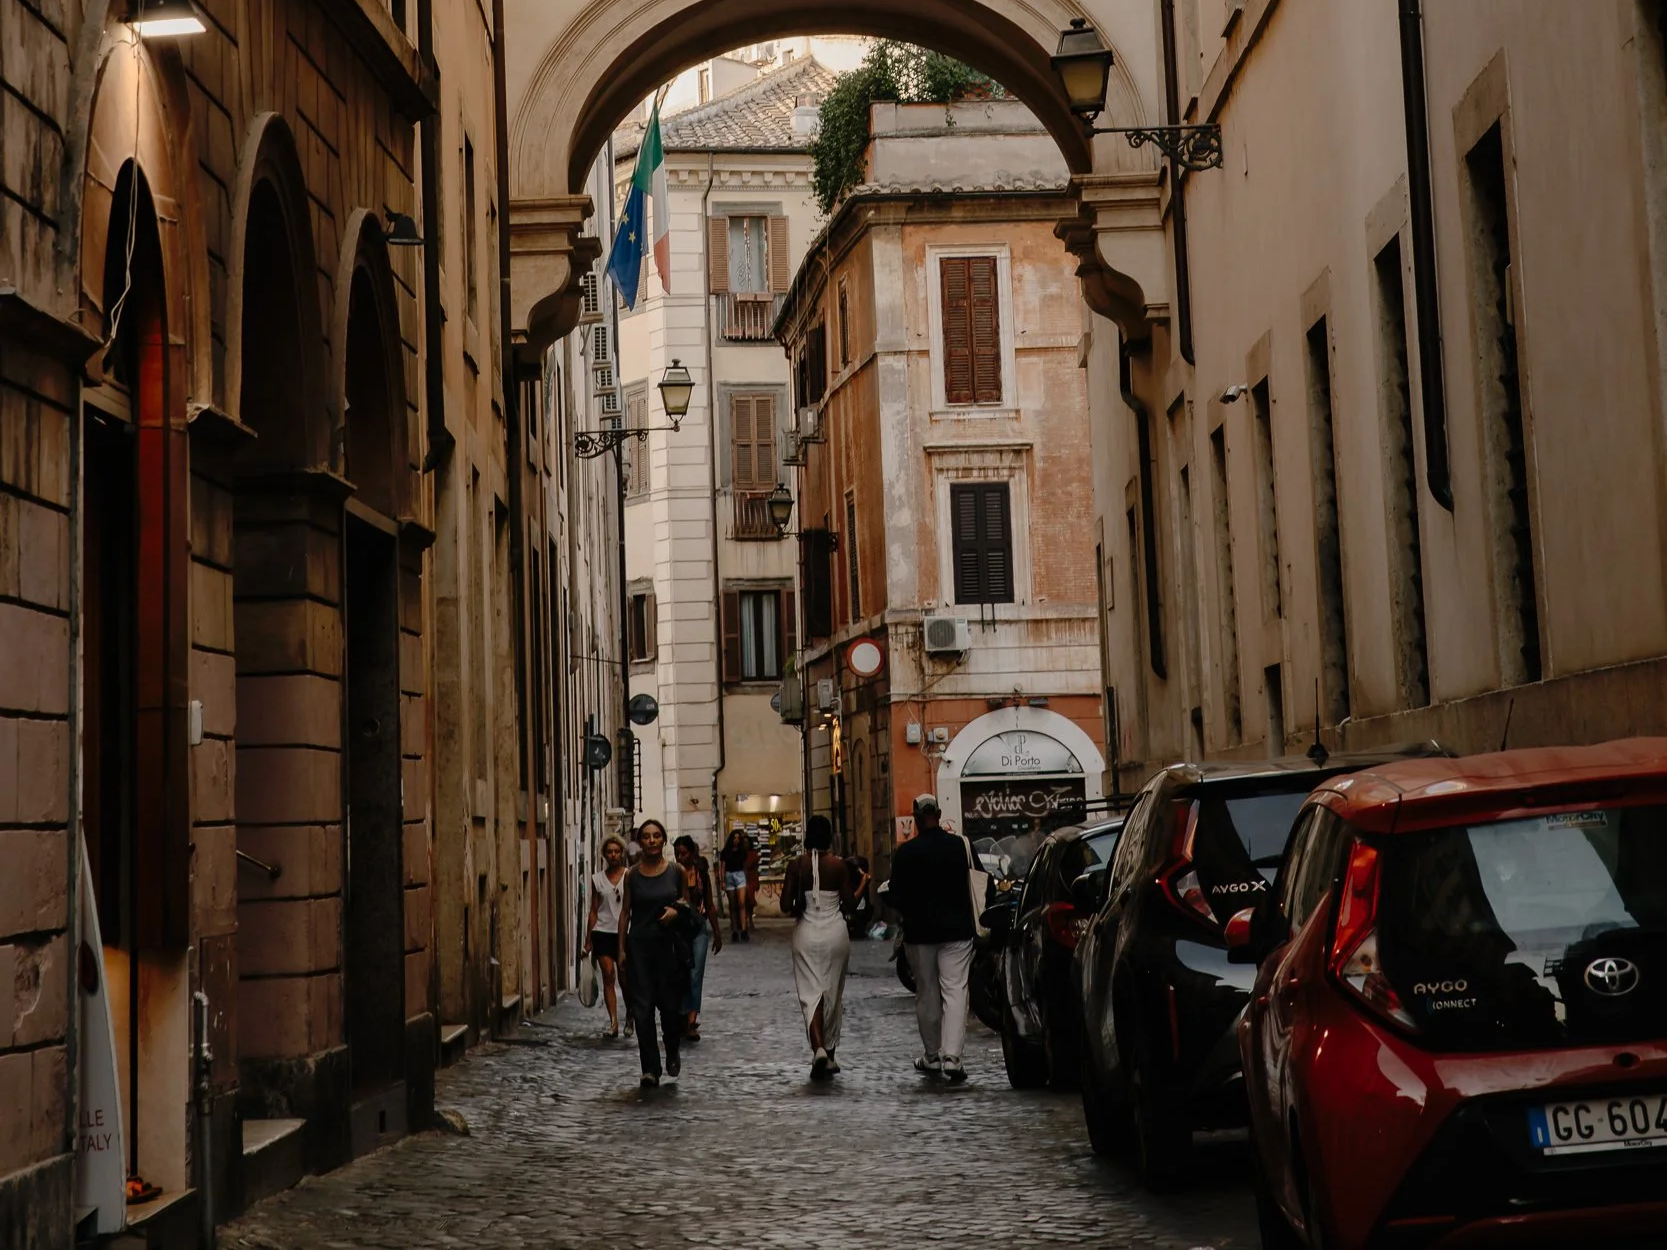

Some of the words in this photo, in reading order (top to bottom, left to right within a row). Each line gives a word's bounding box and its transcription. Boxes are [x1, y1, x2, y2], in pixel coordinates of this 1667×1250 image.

[1001, 755, 1012, 767] Di
[1015, 755, 1041, 766] Porto
[1250, 880, 1267, 892] X
[1413, 979, 1468, 995] AYGO
[1551, 1103, 1595, 1141] GG
